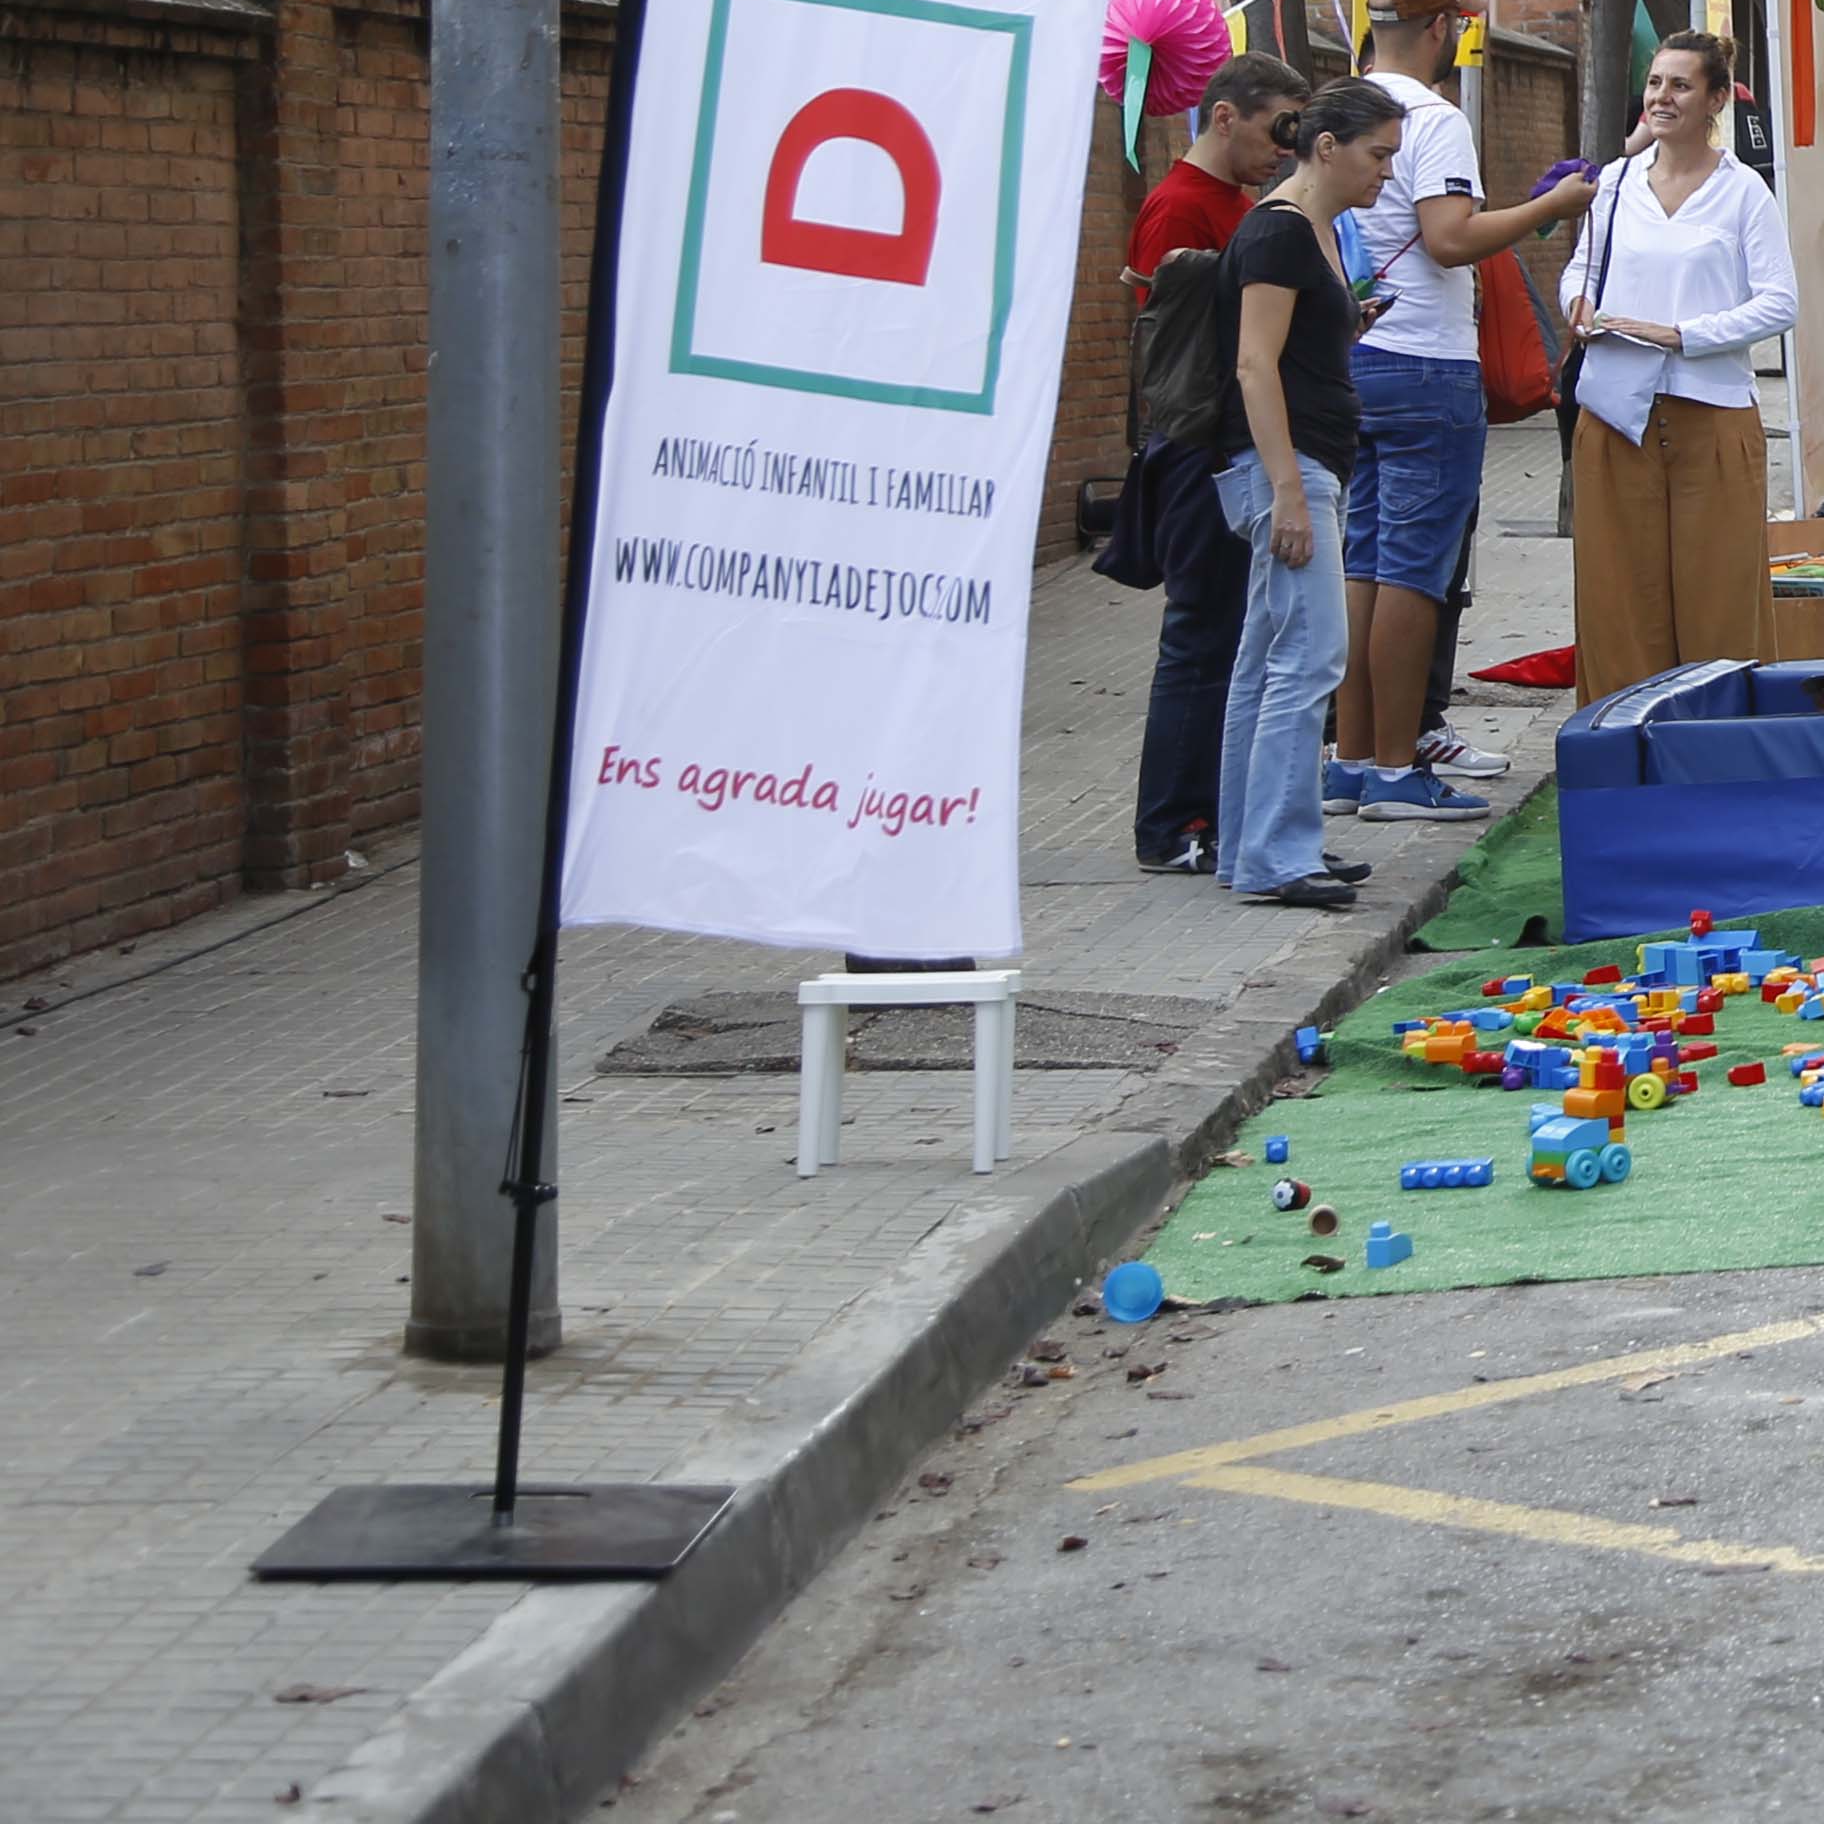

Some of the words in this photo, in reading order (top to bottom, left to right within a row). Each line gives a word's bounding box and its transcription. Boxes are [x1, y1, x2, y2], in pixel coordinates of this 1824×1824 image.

[652, 438, 759, 490] ANIMACIÓ
[760, 450, 859, 505] INFANTIL
[867, 466, 879, 506] I
[886, 468, 995, 520] FAMILIAR
[598, 745, 661, 788] Ens
[677, 764, 840, 811] agrada
[846, 772, 981, 837] jugar!
